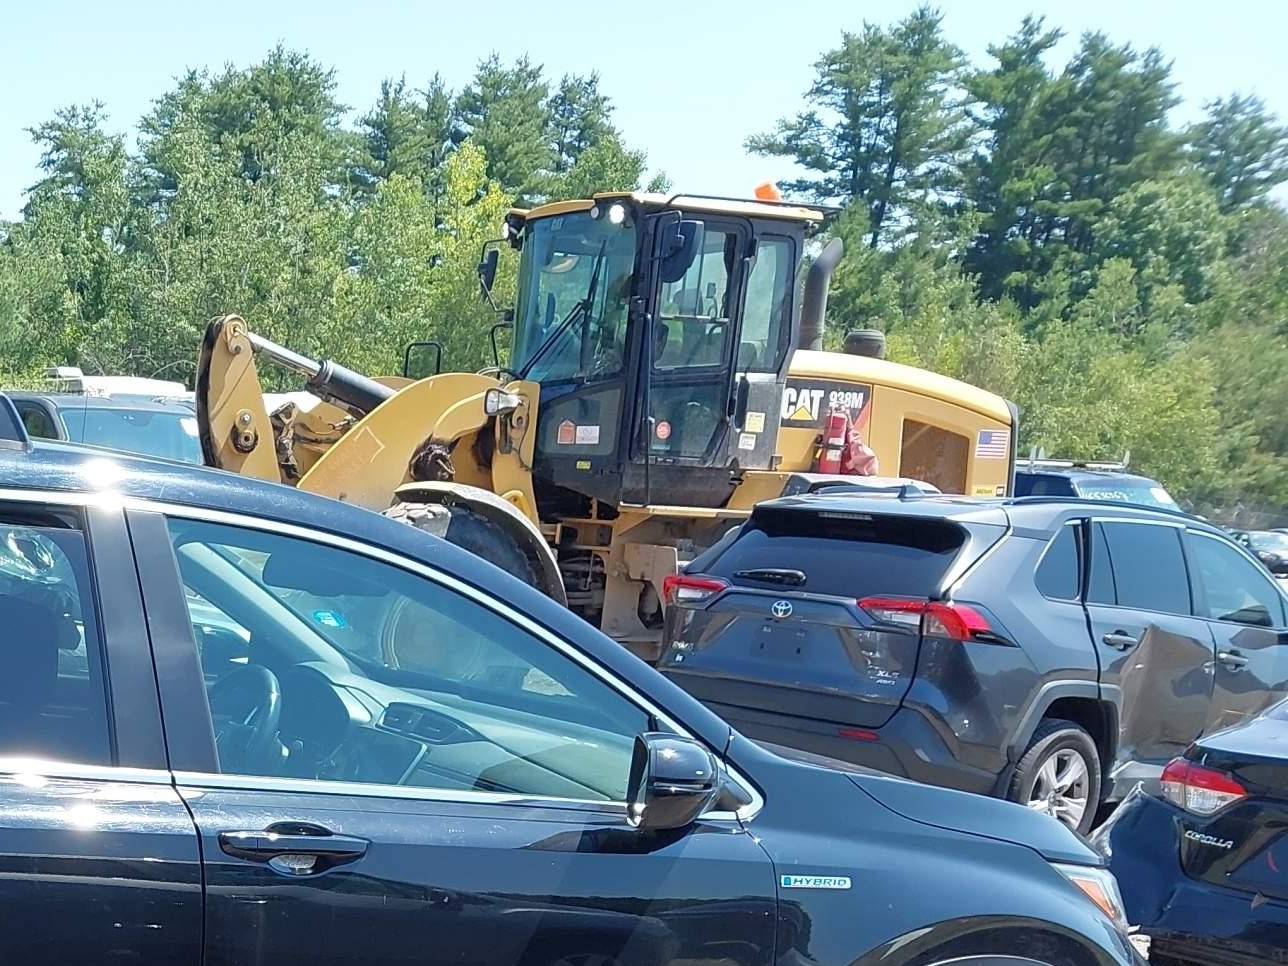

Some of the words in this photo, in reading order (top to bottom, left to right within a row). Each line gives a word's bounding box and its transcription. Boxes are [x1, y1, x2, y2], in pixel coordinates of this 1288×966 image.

[781, 387, 825, 421] CAT
[1184, 829, 1234, 849] COROLLA
[793, 877, 847, 887] HYBRID
